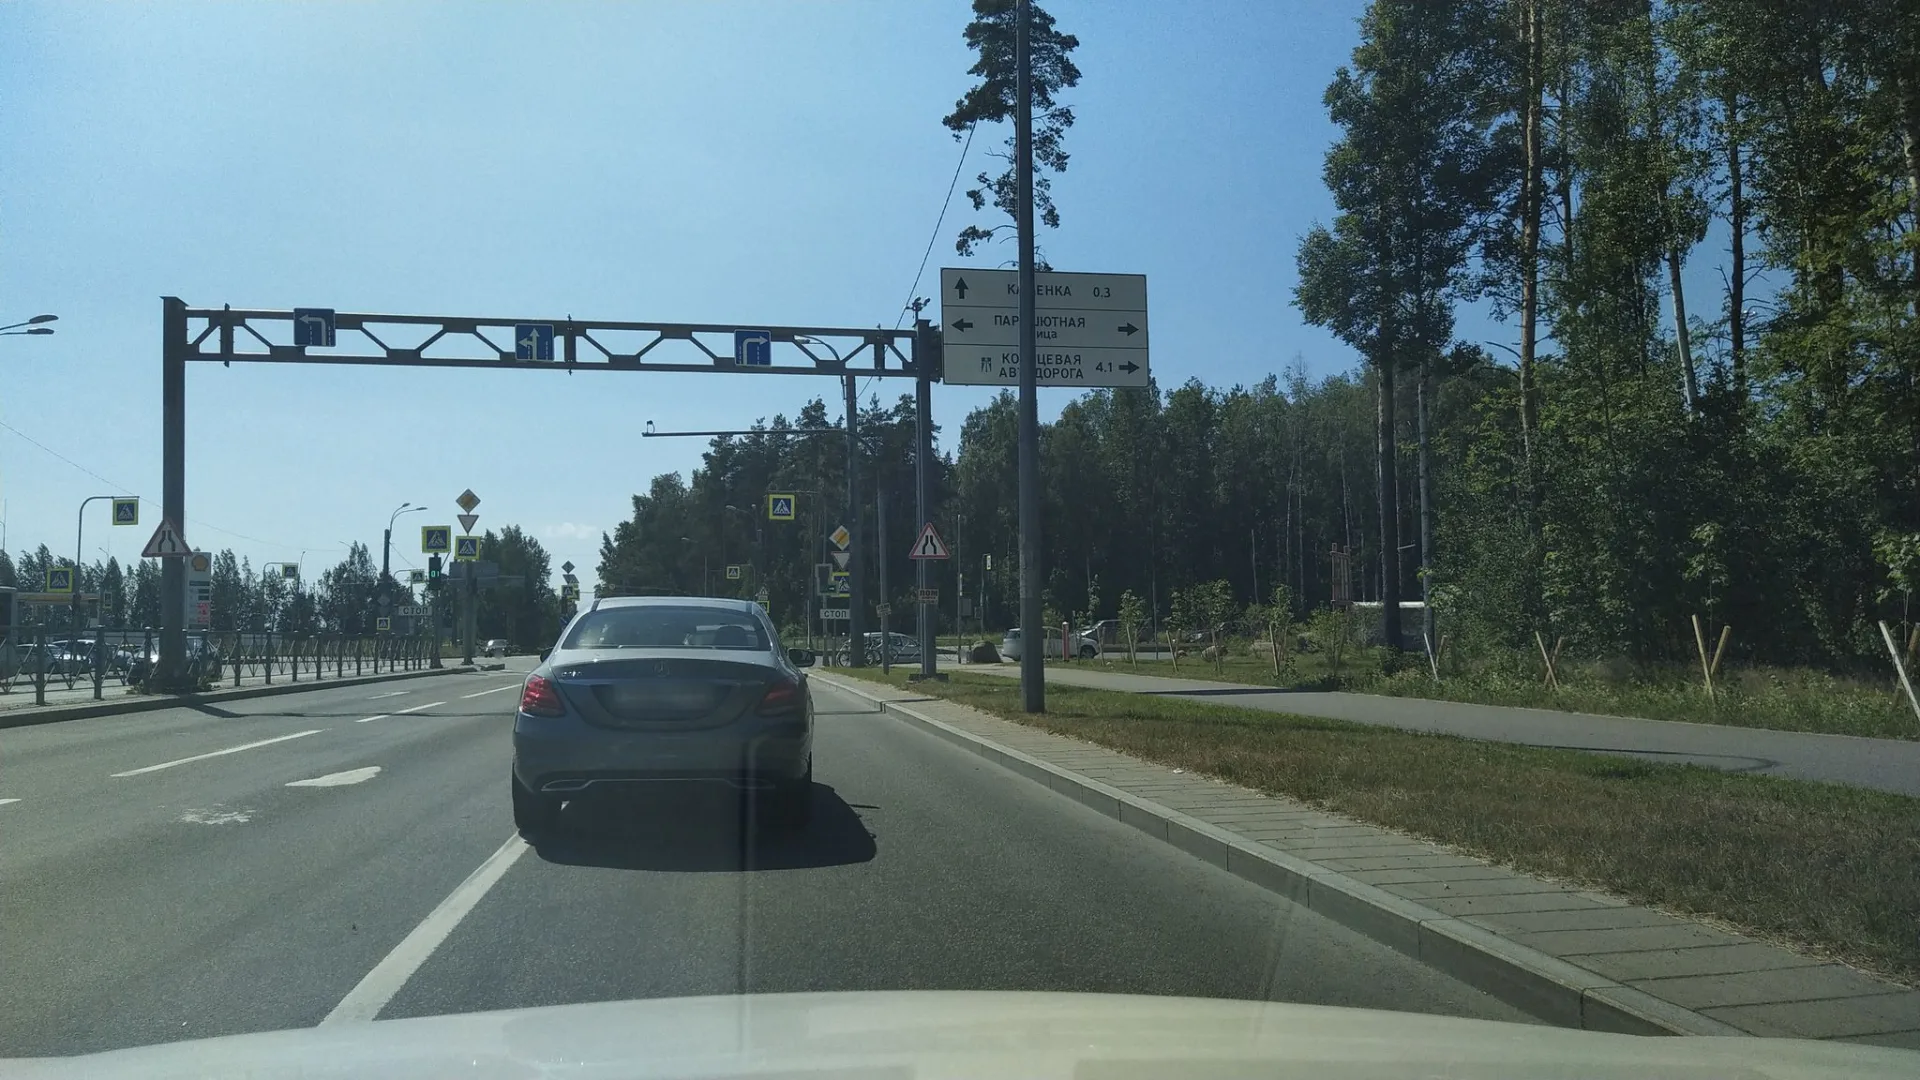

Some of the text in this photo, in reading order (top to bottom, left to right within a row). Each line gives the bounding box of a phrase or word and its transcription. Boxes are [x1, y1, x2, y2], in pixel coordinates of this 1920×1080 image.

[1007, 283, 1111, 298] КЕНКА 0.3
[994, 315, 1086, 328] ПАРЮТНАЯ
[1002, 352, 1081, 366] КОЦЕВАЯ
[999, 367, 1084, 380] АВДОРОГА
[1095, 361, 1112, 373] 4.1
[403, 606, 429, 615] СТОП
[823, 610, 847, 618] СТОП
